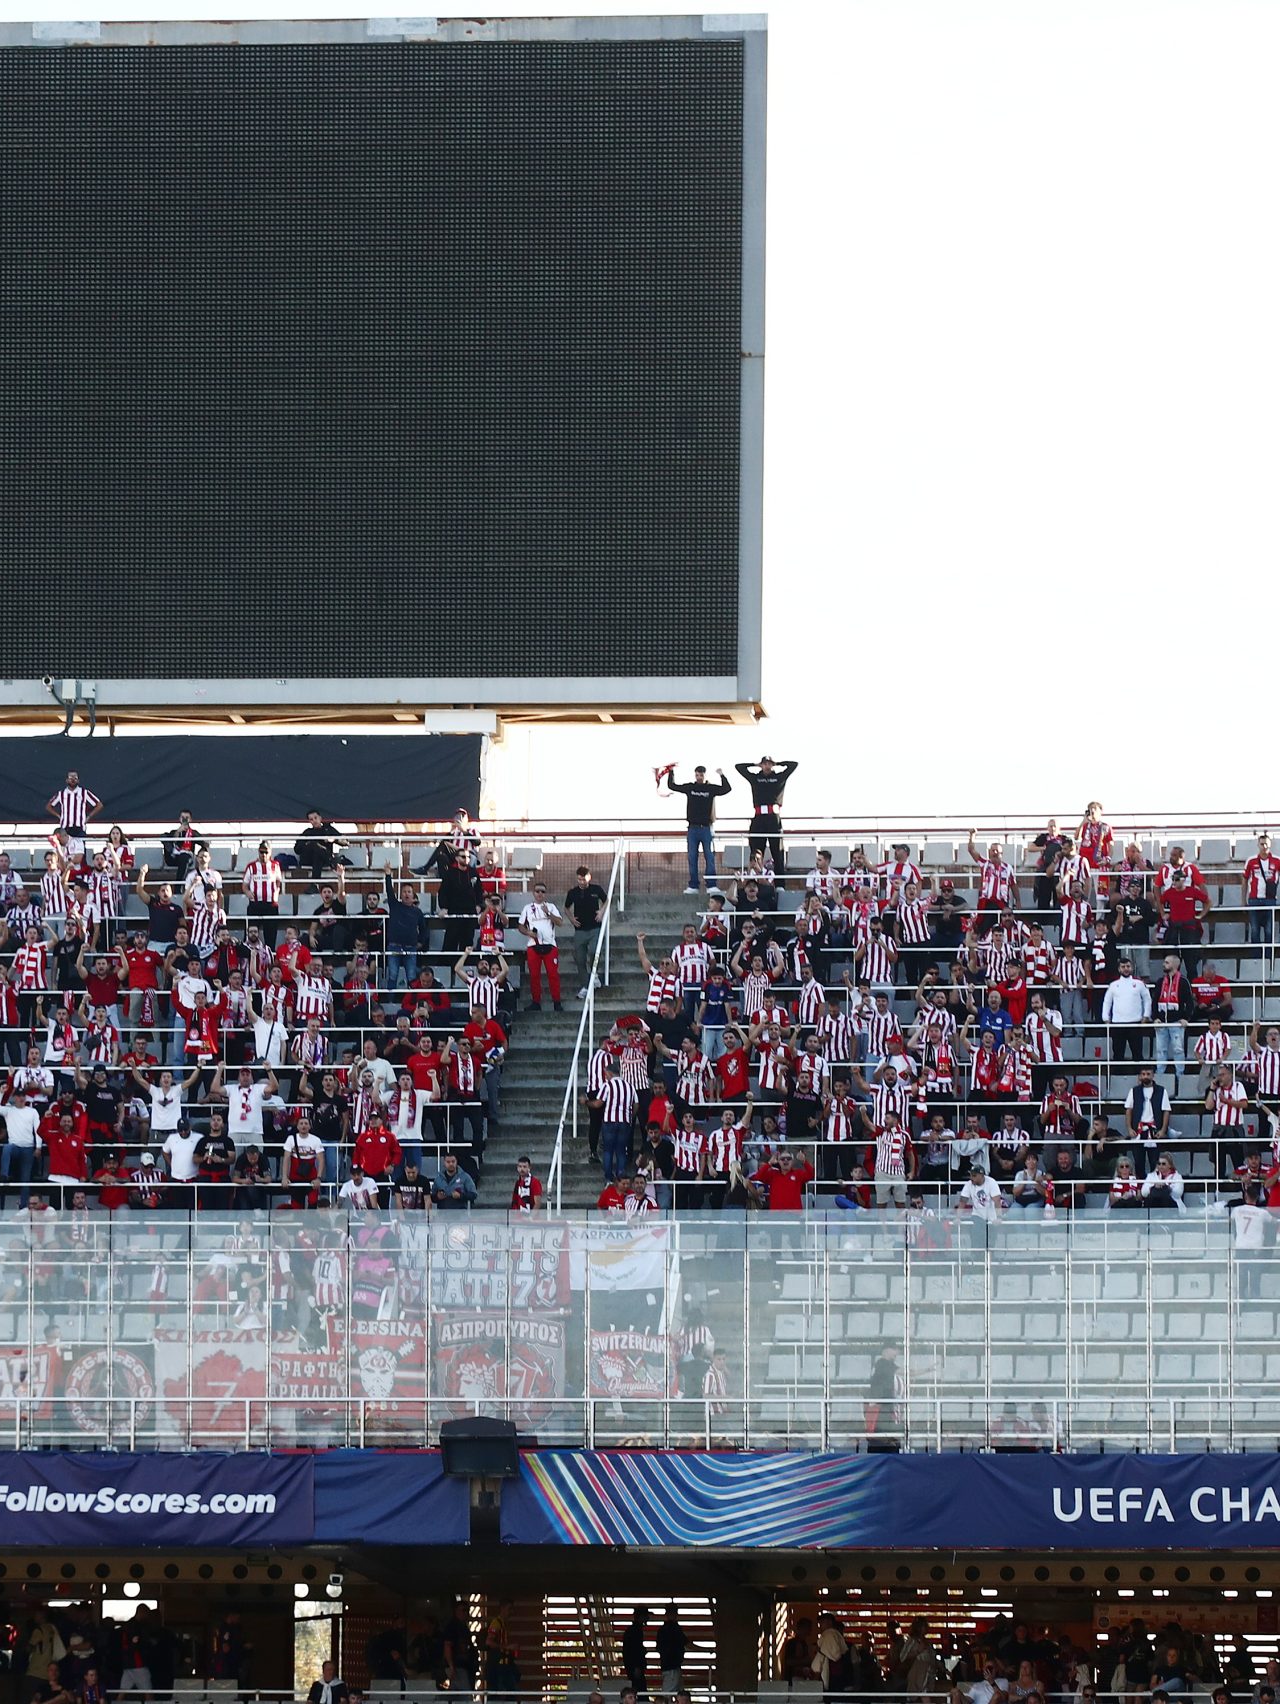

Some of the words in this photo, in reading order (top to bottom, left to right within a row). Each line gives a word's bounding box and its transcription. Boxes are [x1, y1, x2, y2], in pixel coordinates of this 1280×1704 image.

[570, 1229, 633, 1240] ΧΛΩΡΑΚΑ
[422, 1272, 509, 1306] GATE
[513, 1273, 536, 1307] 7
[334, 1319, 424, 1337] ELEFSINA
[441, 1319, 559, 1344] ΑΣΠΡΟΠΥΡΓΟΣ
[592, 1334, 671, 1354] SWITZERLAN
[207, 1381, 238, 1425] 7
[1053, 1487, 1175, 1522] UEFA
[1189, 1486, 1280, 1523] CHA
